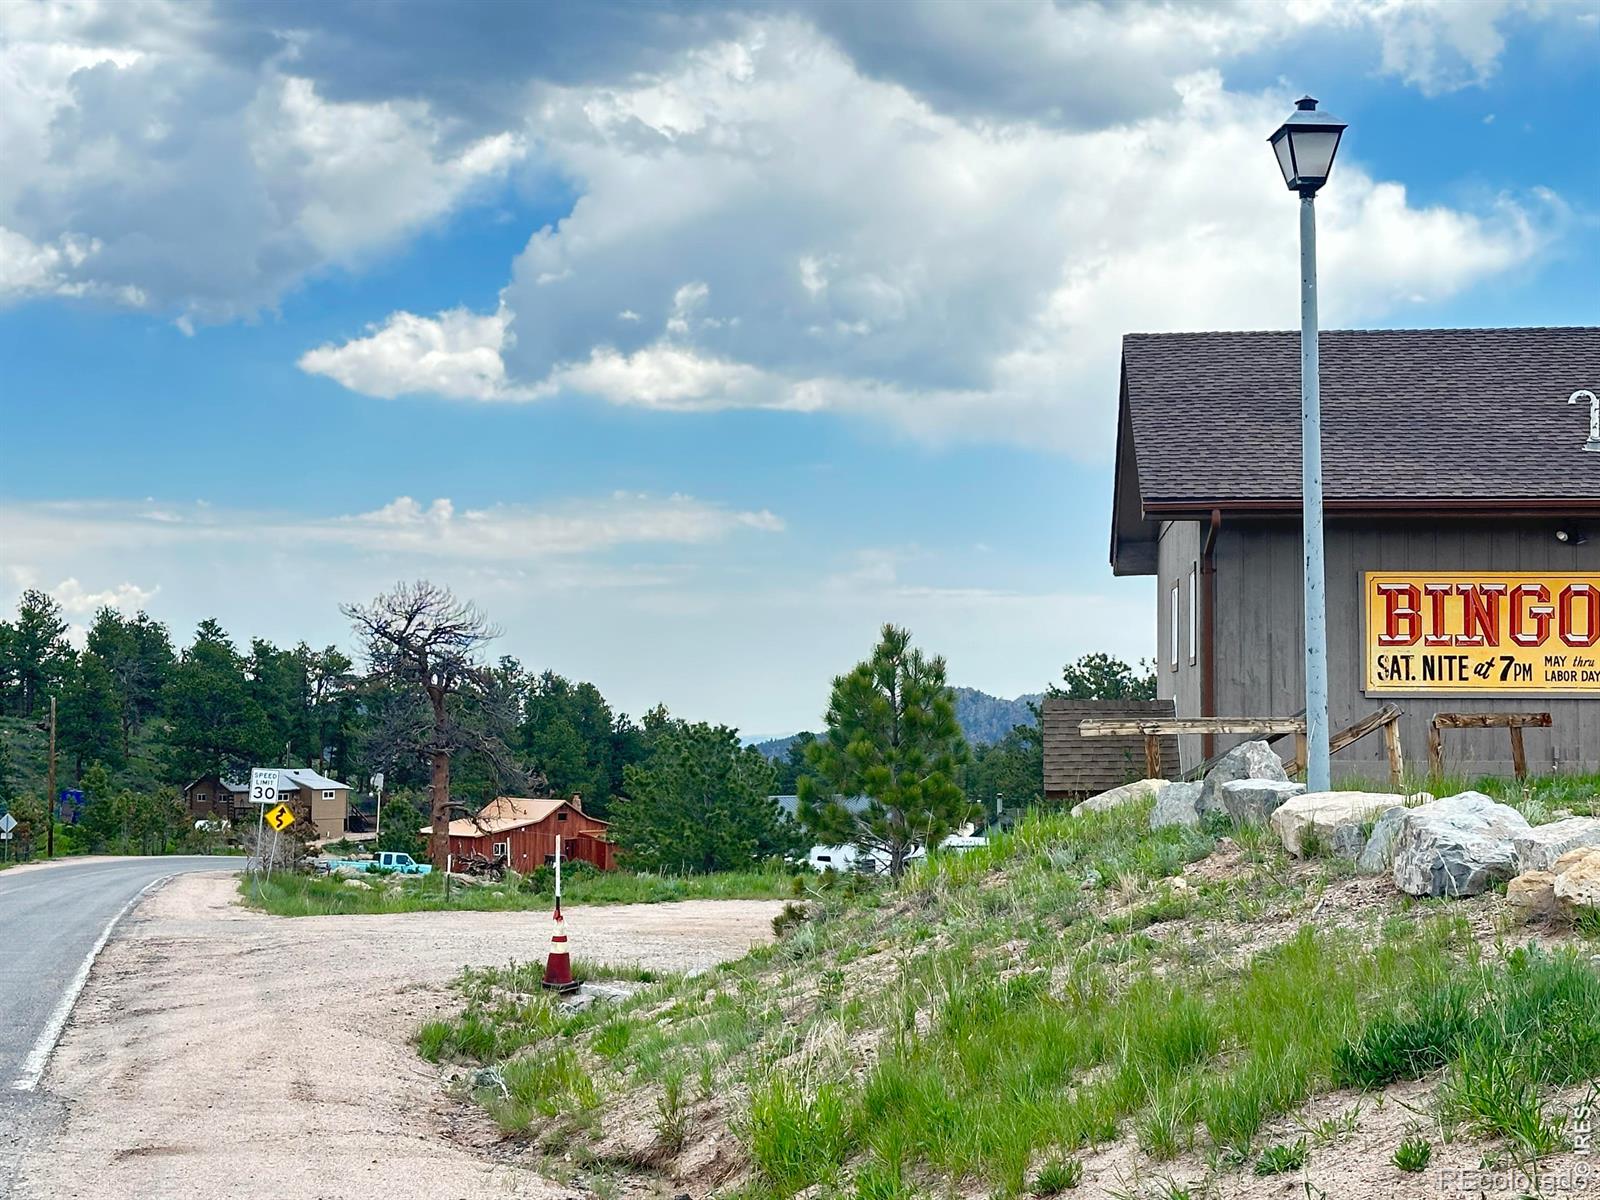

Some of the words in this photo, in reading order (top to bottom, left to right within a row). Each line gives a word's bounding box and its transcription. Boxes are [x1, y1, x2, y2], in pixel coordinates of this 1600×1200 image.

[1377, 583, 1600, 647] BINGO
[1377, 655, 1416, 681] SAT.
[1422, 655, 1469, 681] NITE
[1473, 657, 1495, 679] at
[1499, 656, 1533, 681] 7PM
[1544, 656, 1567, 667] MAY
[1572, 656, 1595, 668] thru
[1544, 671, 1578, 682] LABOR
[1581, 671, 1600, 682] DAY
[253, 786, 274, 799] 30
